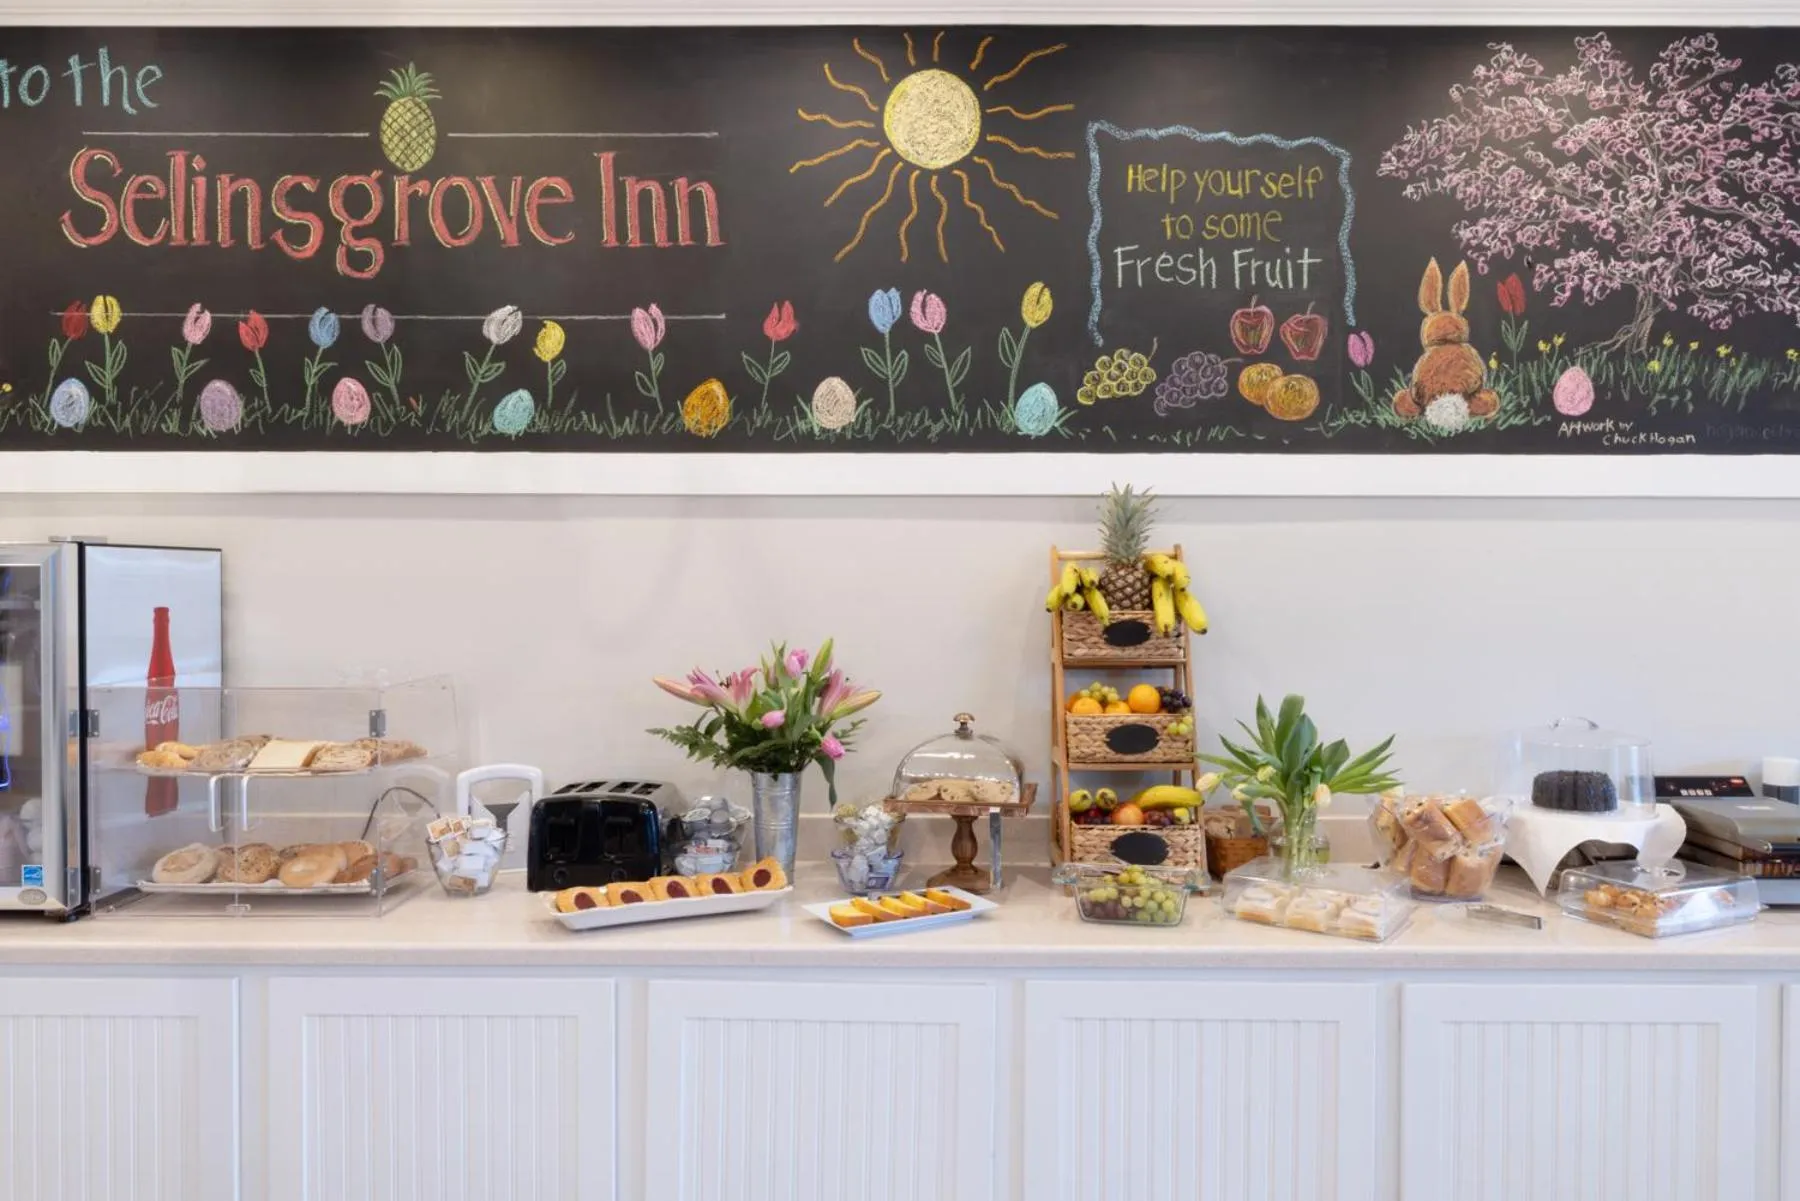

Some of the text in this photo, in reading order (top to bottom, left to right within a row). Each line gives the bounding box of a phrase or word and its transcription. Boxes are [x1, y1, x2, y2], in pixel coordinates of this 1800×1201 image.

[0, 46, 162, 115] to the
[1127, 163, 1324, 203] Help yourself
[60, 147, 726, 279] Selinsgrove Inn
[1161, 210, 1283, 242] to some
[1114, 244, 1323, 290] Fresh Fruit
[1557, 418, 1614, 438] Artwork
[1602, 432, 1646, 446] Chuck
[1650, 432, 1697, 445] Hogan
